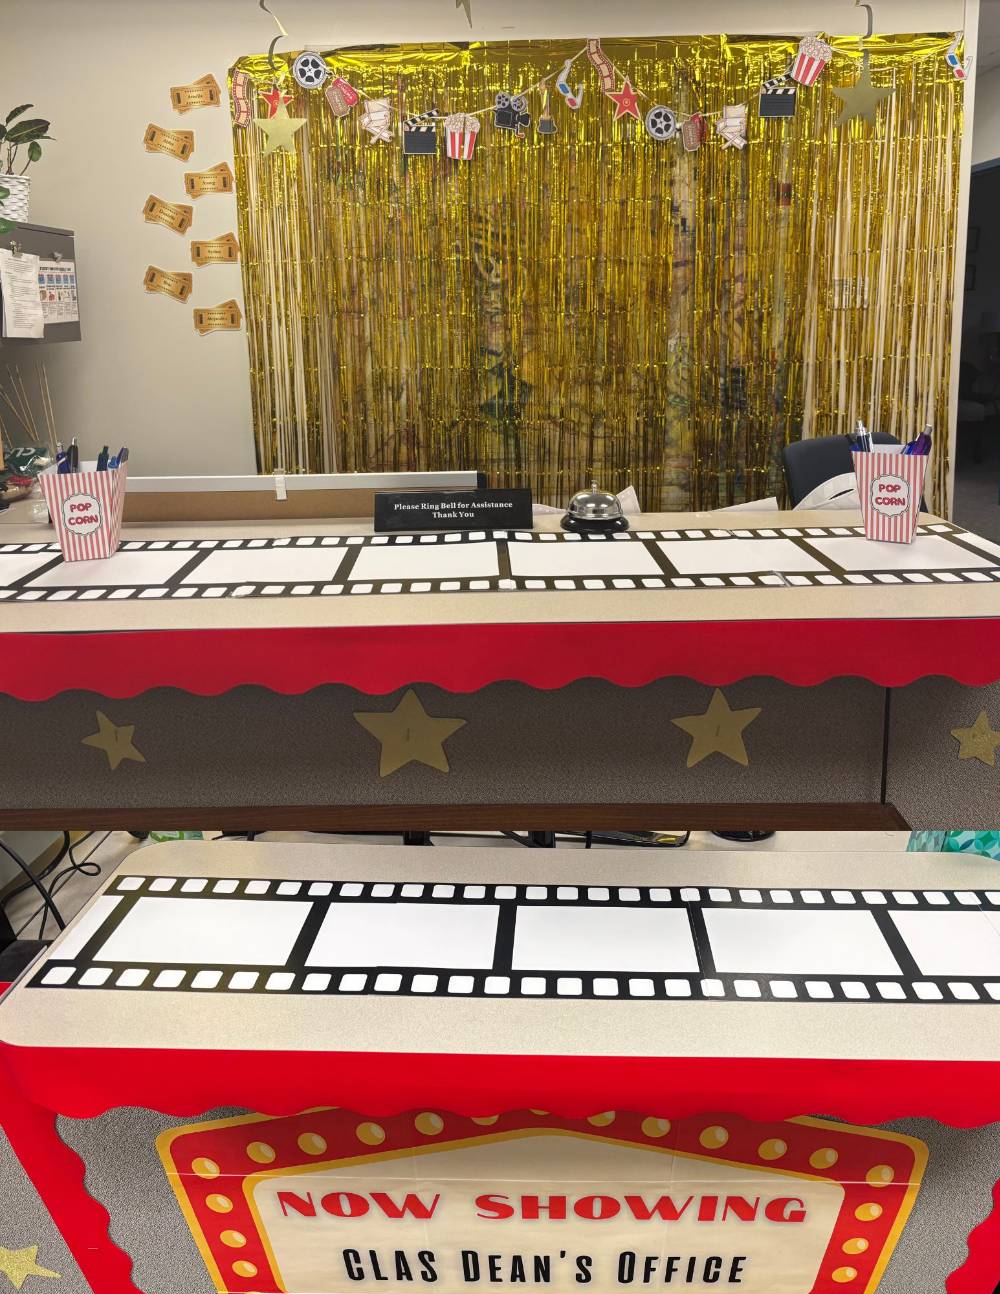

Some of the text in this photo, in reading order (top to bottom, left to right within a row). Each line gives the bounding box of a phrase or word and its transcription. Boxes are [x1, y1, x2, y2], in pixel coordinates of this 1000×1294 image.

[879, 484, 901, 493] POP
[875, 497, 905, 506] CORN
[70, 503, 92, 512] POP
[421, 503, 440, 511] Ring
[68, 515, 98, 525] CORN
[278, 1190, 807, 1225] NOW SHOWING
[341, 1248, 748, 1286] CLAS DEAN'S OFFICE
